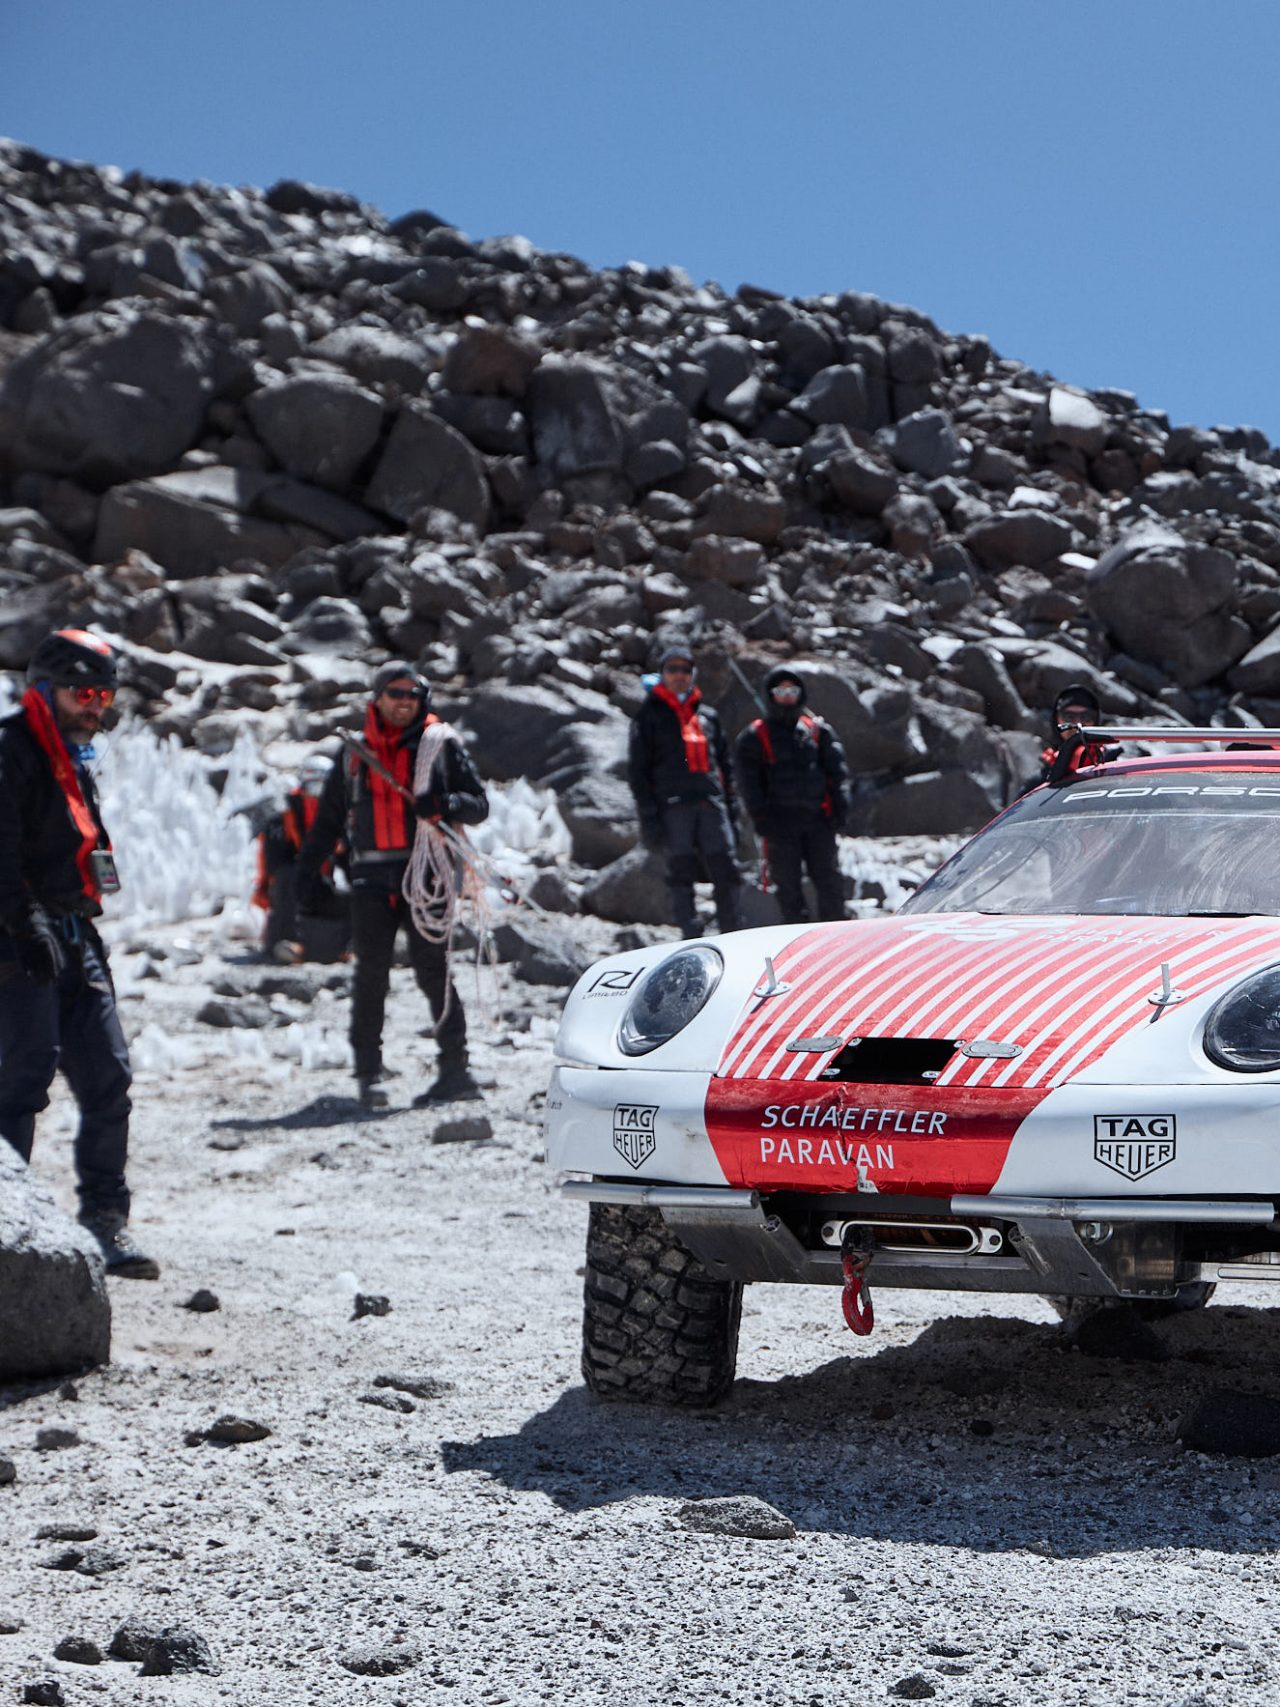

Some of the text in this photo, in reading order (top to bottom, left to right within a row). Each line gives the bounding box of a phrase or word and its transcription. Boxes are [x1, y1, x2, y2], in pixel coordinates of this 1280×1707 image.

[617, 1108, 653, 1128] TAG
[761, 1105, 949, 1136] SCHAEFFLER
[1101, 1118, 1169, 1138] TAG
[615, 1132, 654, 1164] HEUER
[760, 1137, 895, 1169] PARAVAN
[1099, 1144, 1171, 1175] HEUER
